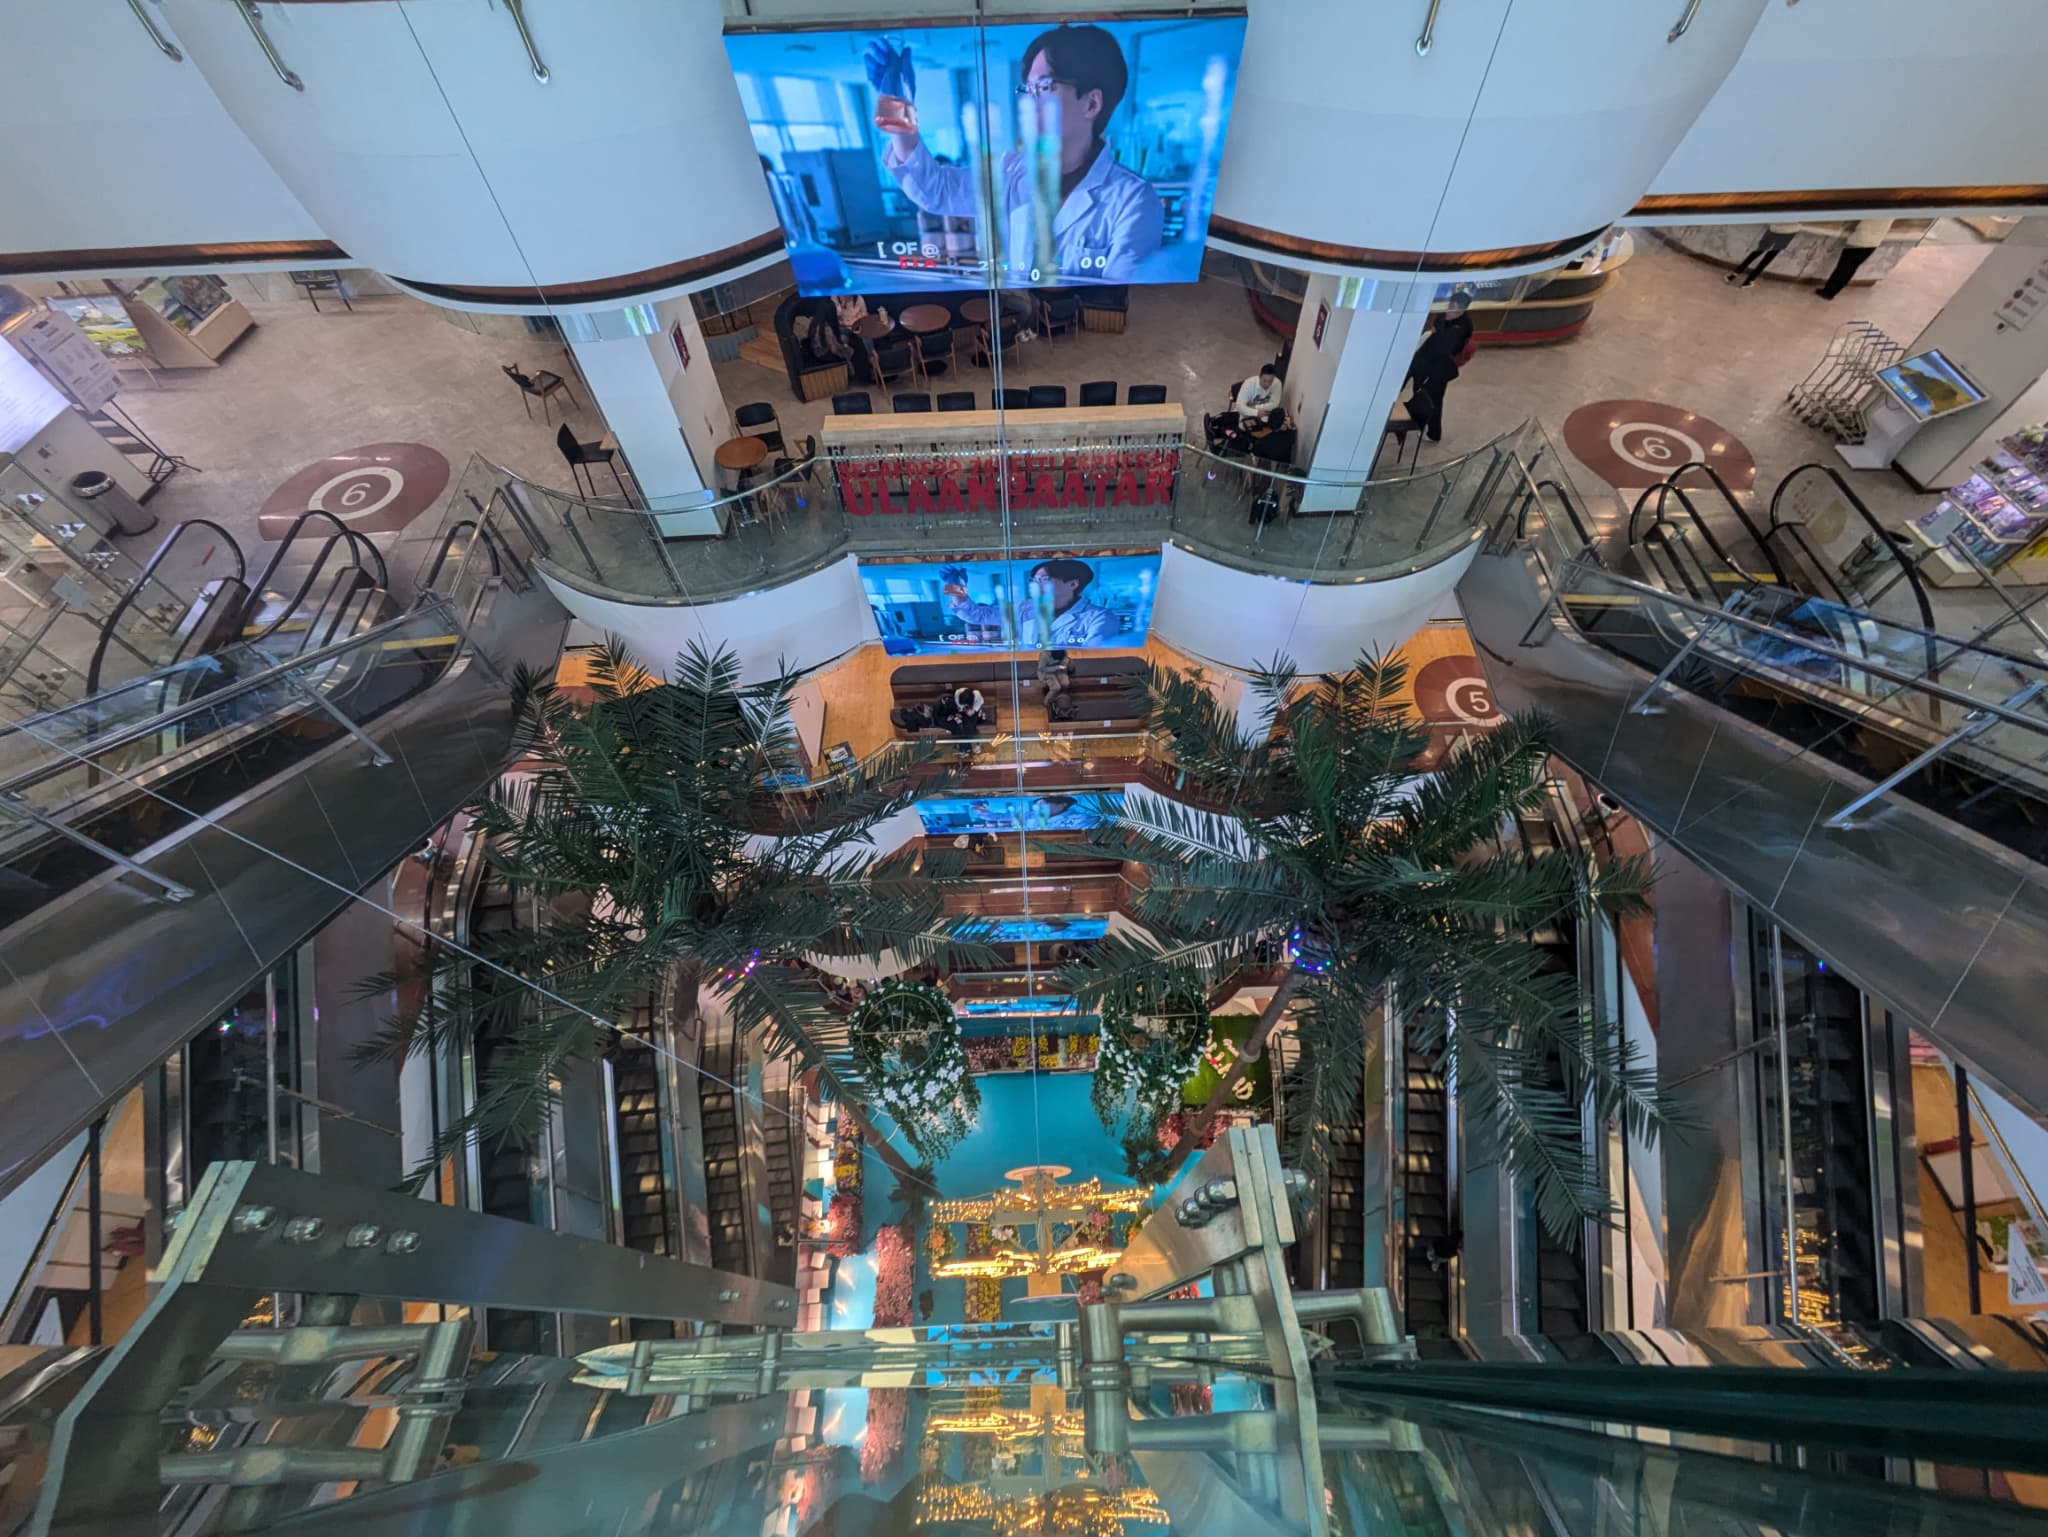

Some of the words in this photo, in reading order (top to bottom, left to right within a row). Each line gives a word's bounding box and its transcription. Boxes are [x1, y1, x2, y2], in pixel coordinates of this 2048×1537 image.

[1642, 436, 1672, 459] 6
[341, 482, 371, 506] 6
[1468, 691, 1490, 713] 5
